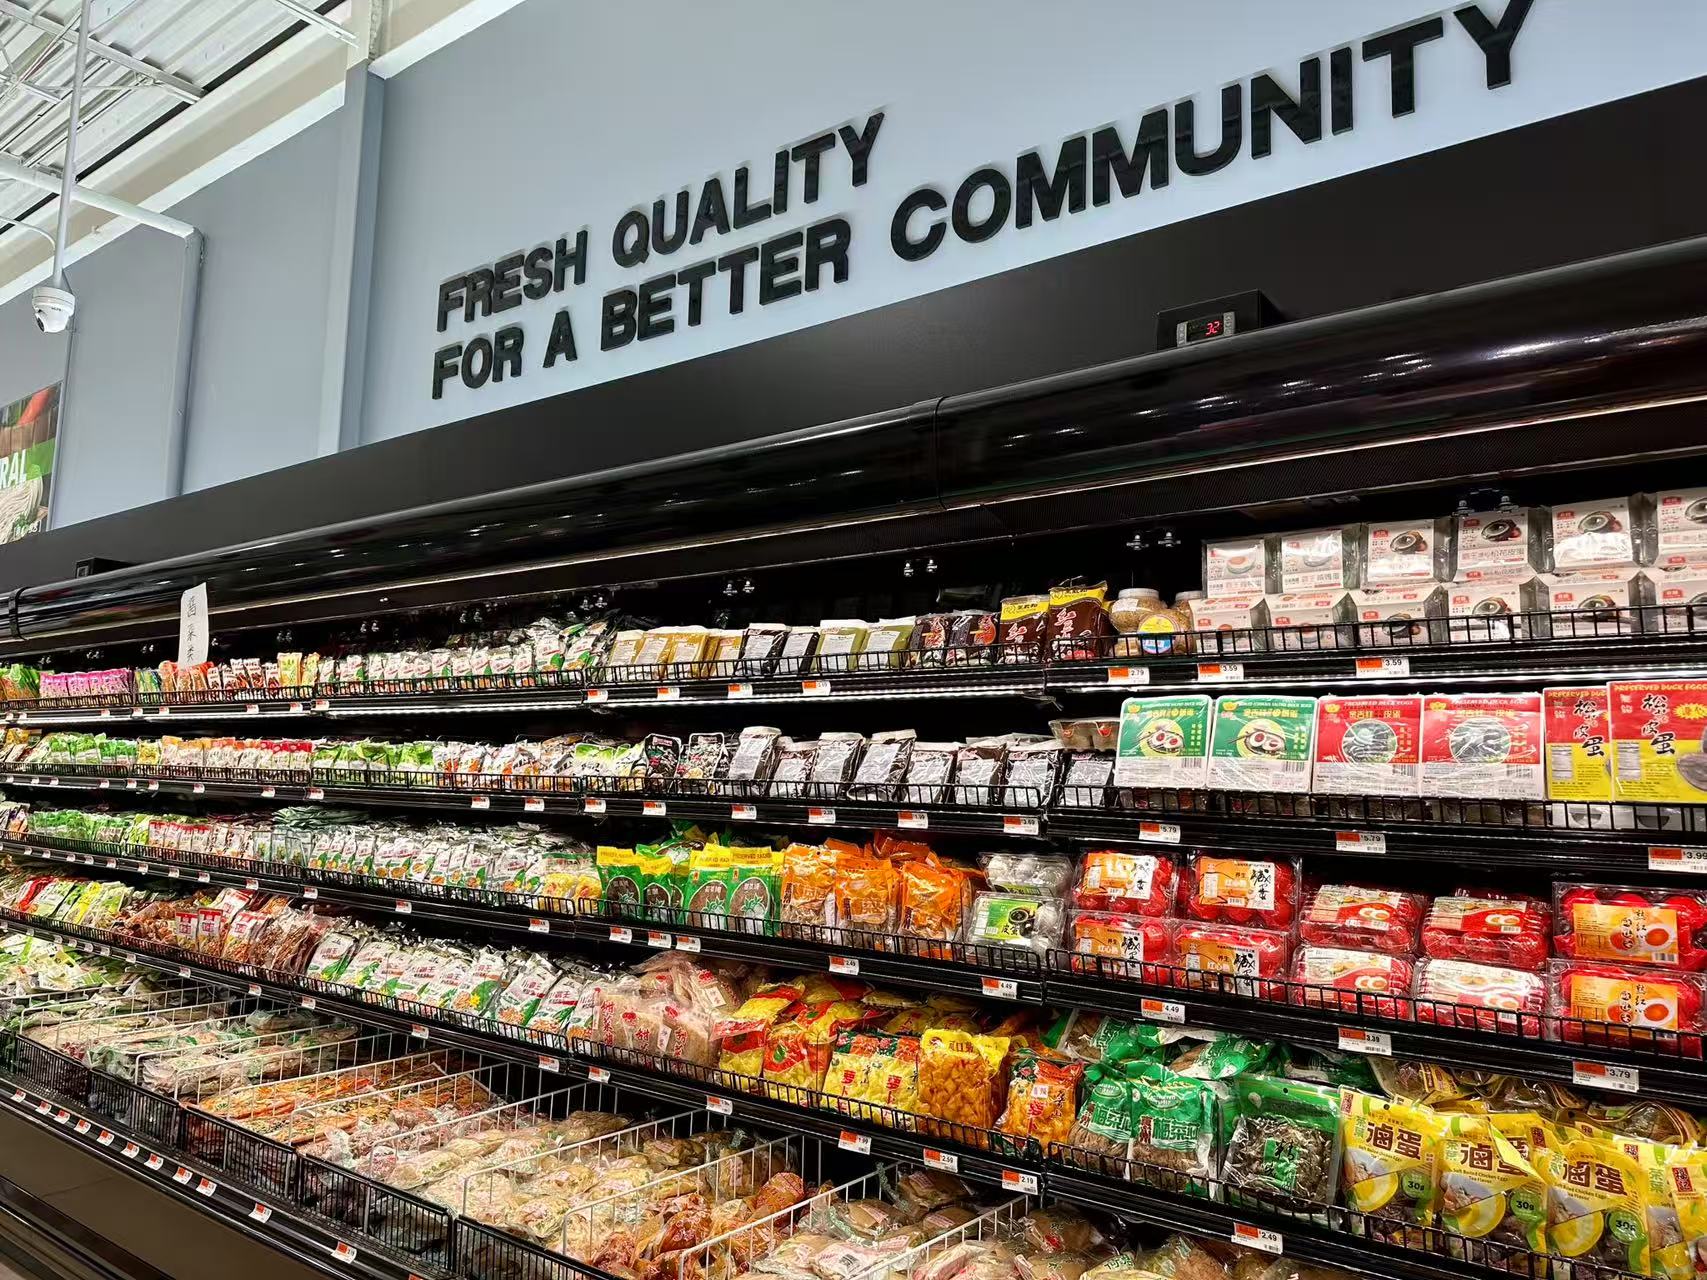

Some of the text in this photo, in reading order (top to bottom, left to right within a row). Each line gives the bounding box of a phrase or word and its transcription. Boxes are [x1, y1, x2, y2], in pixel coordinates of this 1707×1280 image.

[431, 0, 1537, 400] FOR A BETTER COMMUNITY
[436, 111, 886, 333] FRESH QUALITY
[1205, 320, 1220, 336] 32
[1516, 1200, 1534, 1211] 30g
